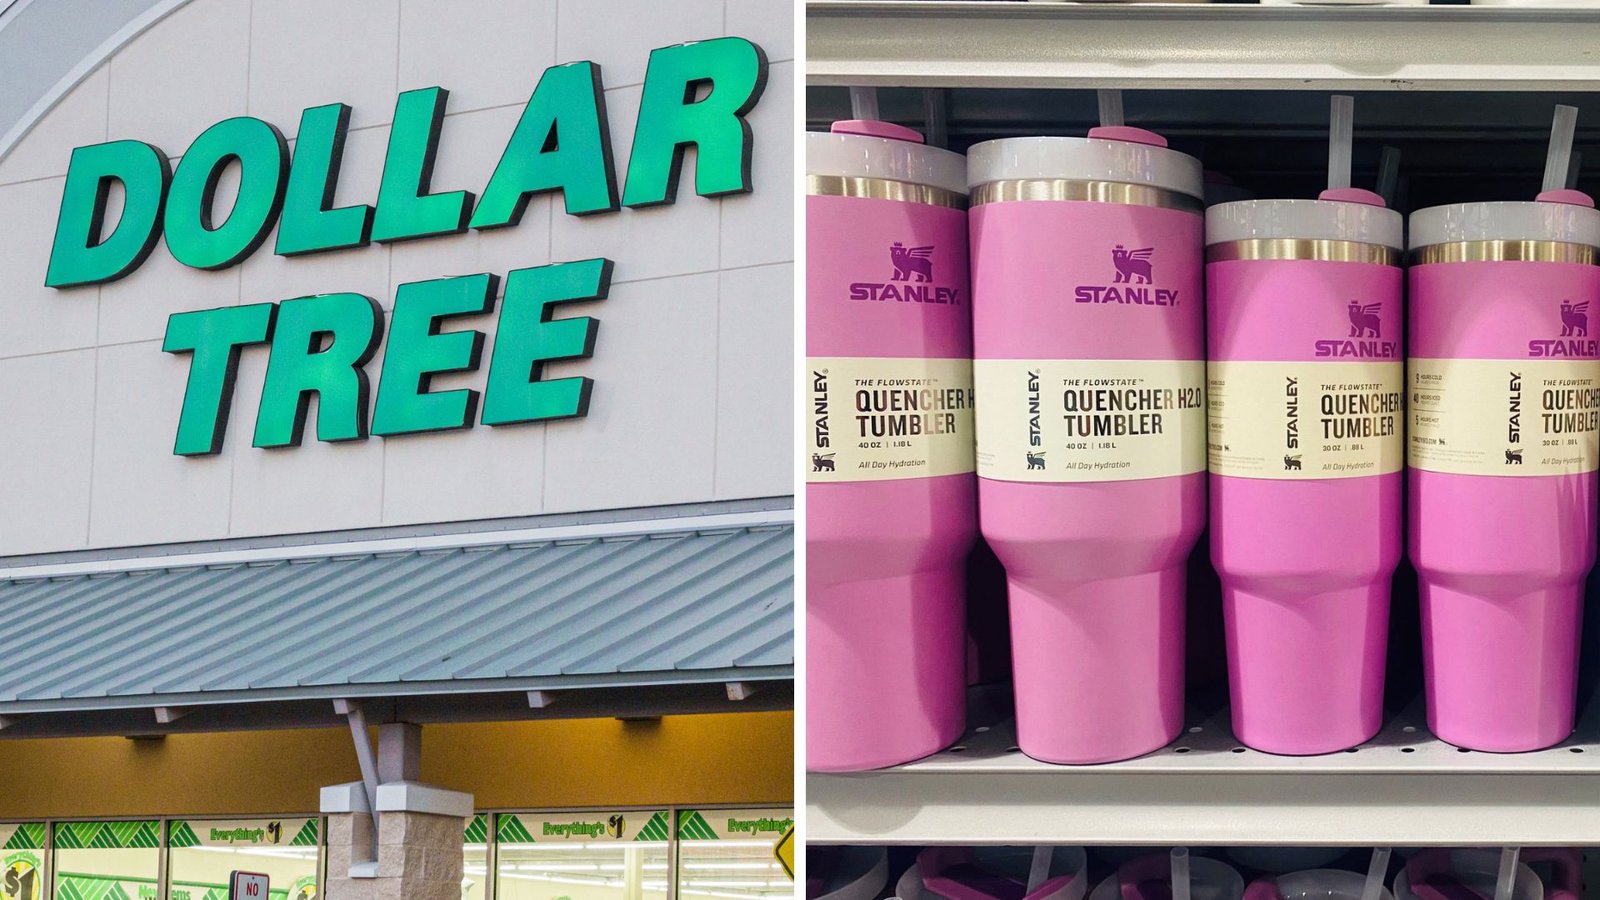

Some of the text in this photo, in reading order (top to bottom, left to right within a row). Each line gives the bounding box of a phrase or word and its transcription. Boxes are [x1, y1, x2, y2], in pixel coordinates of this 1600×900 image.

[44, 36, 769, 289] DOLLAR
[850, 283, 958, 304] STANLEY
[1075, 286, 1179, 306] STANLEY
[162, 256, 615, 456] TREE
[1315, 340, 1397, 358] STANLEY
[1529, 339, 1600, 357] STANLEY
[813, 371, 829, 448] STANLEY
[856, 388, 965, 412] QUENCHER
[1028, 370, 1041, 447] STANLEY
[1063, 389, 1174, 412] QUENCHER
[1178, 387, 1201, 408] H2.0
[1321, 392, 1399, 415] QUENCHER
[1509, 371, 1521, 443] STANLEY
[1542, 388, 1600, 411] QUENCHE
[1286, 376, 1298, 449] STANLEY
[1541, 411, 1598, 434] TUMBLER
[856, 413, 956, 437] TUMBLER
[1063, 413, 1163, 437] TUMBLER
[1321, 416, 1394, 439] TUMBLER
[858, 459, 926, 470] All Day Hydration
[1066, 461, 1131, 471] All Day Hydration
[543, 820, 605, 839] Everything's
[4, 866, 36, 900] $1
[246, 882, 259, 896] NO
